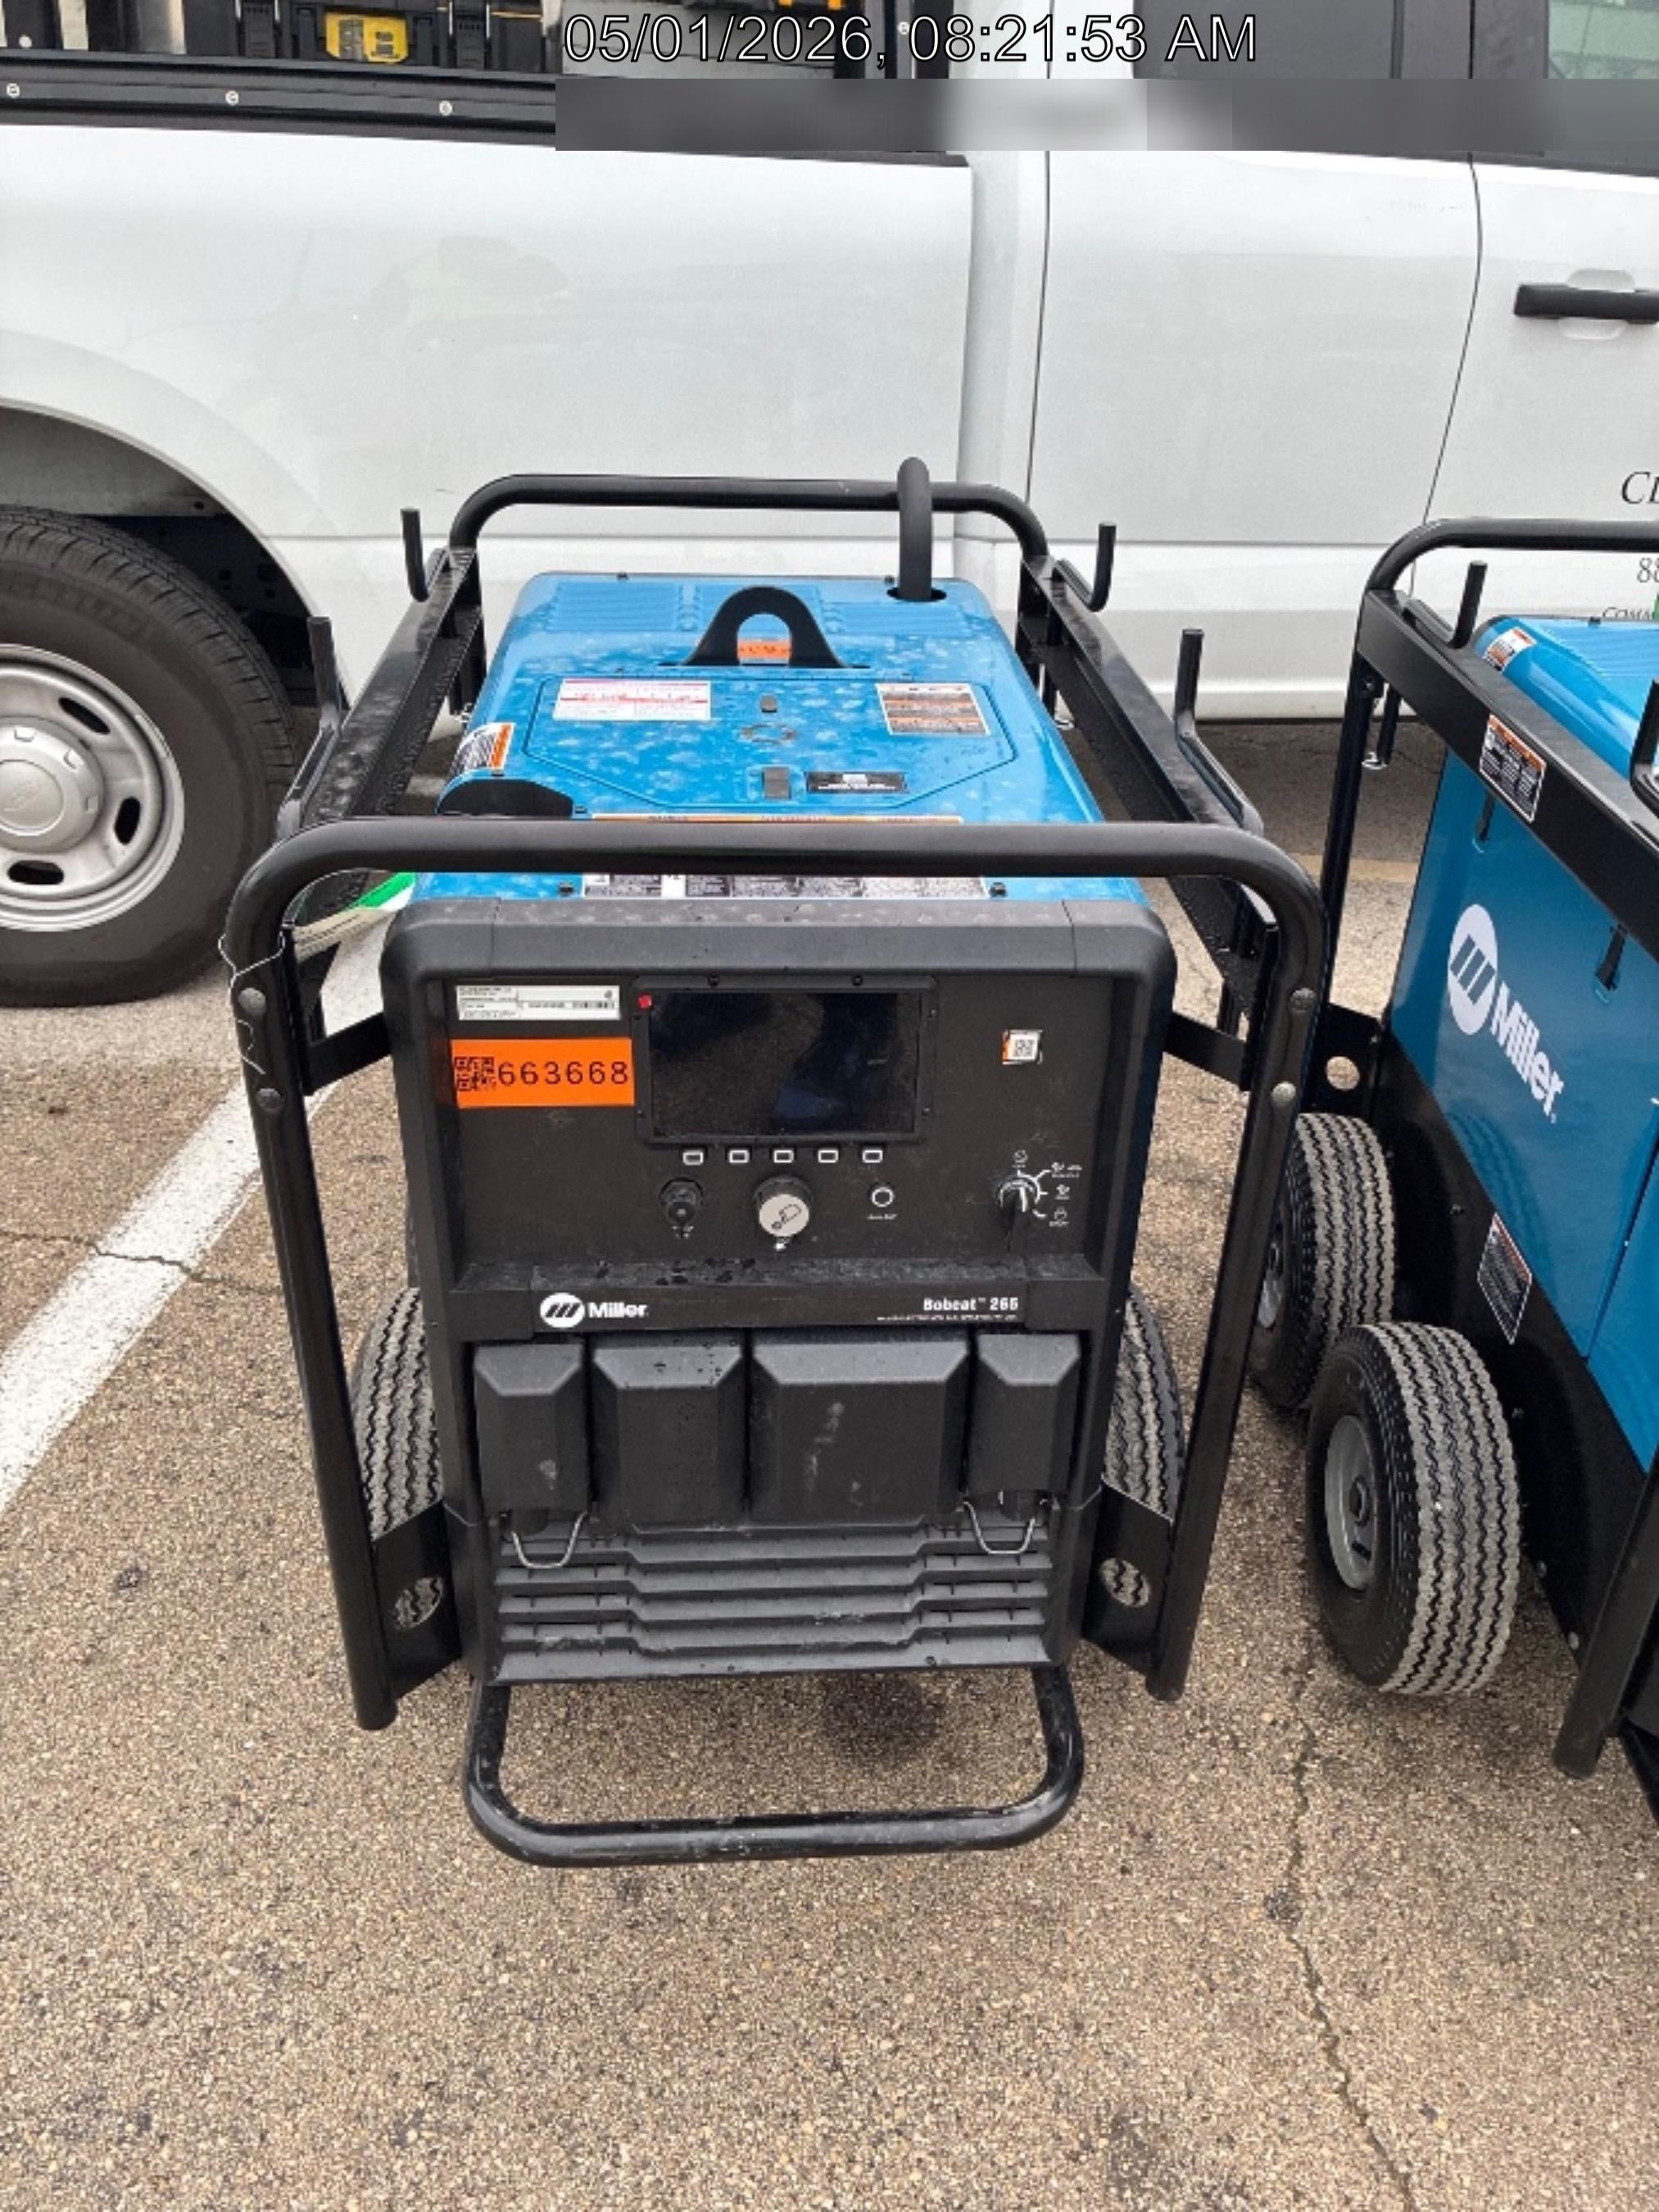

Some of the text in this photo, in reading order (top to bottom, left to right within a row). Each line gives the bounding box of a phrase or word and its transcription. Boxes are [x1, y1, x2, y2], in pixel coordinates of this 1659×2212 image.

[1490, 980, 1565, 1118] Miller
[497, 1060, 628, 1086] 663668
[587, 1302, 648, 1318] Miller
[989, 1297, 1018, 1312] 265
